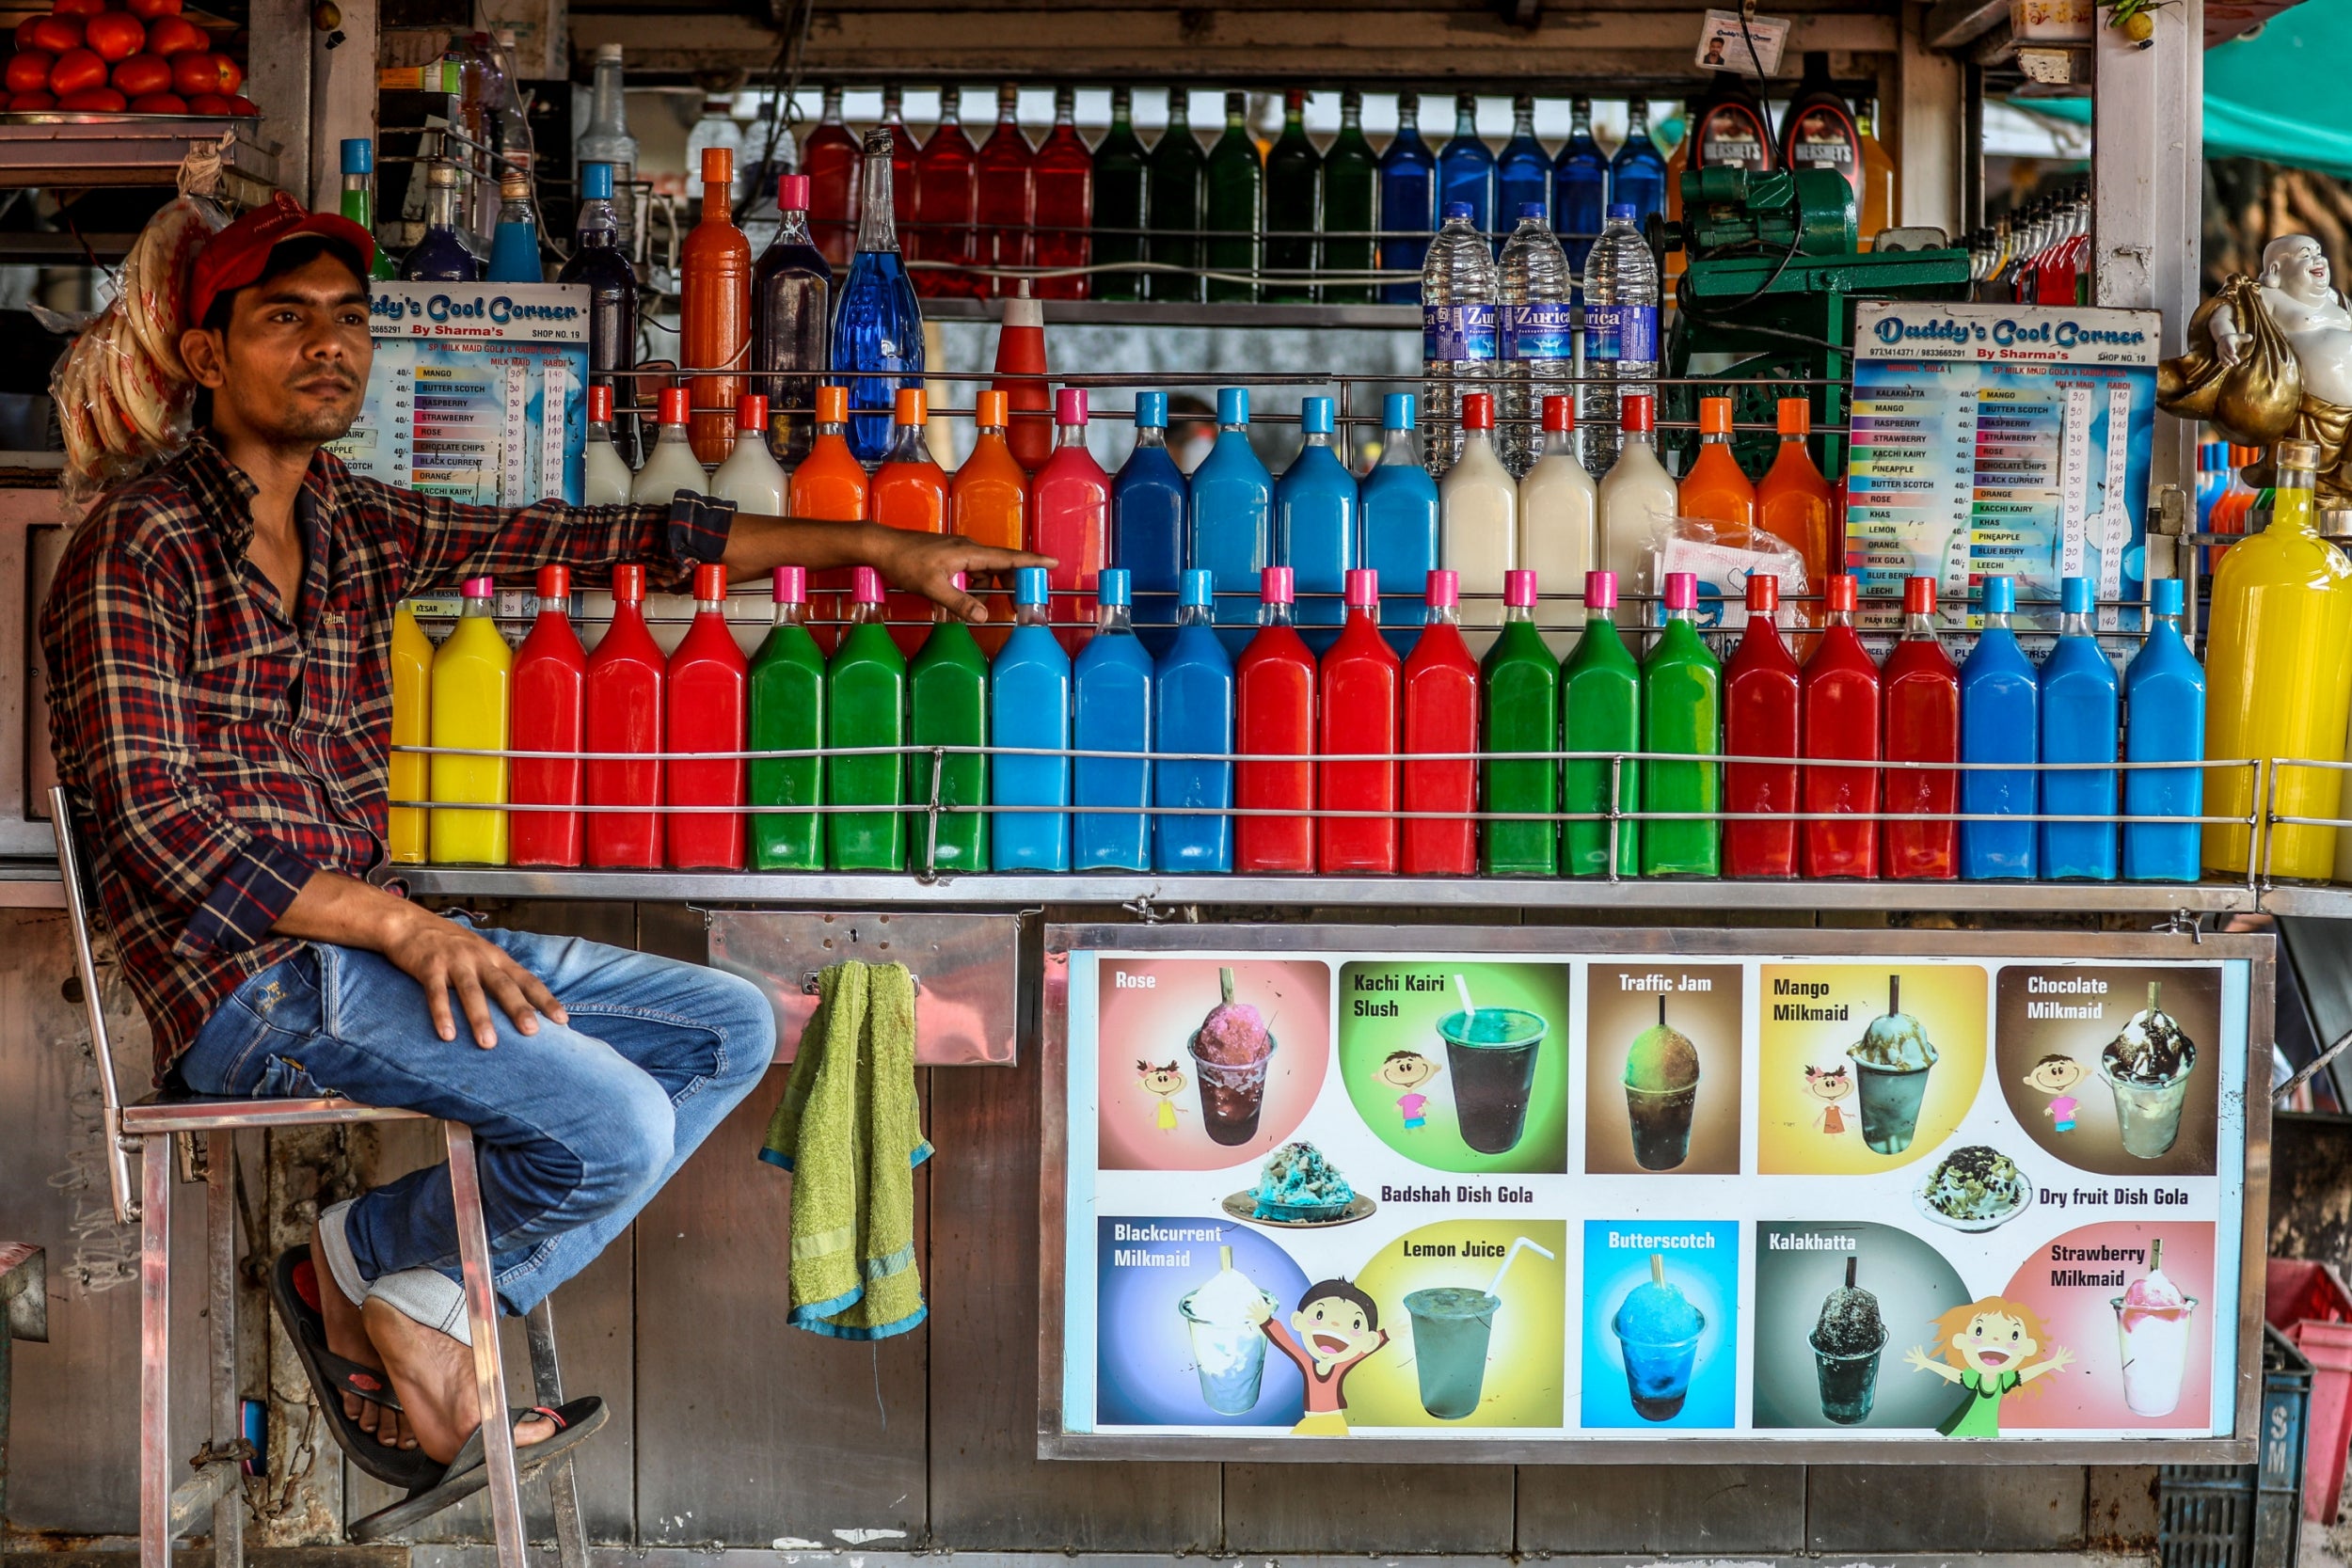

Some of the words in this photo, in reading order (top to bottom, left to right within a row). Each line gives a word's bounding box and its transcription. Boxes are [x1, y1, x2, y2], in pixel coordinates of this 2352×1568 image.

[427, 294, 484, 322] Cool
[489, 296, 578, 324] Corner
[1517, 307, 1570, 325] Zurica
[413, 325, 430, 336] By
[435, 325, 503, 337] Sharma's
[1874, 317, 1986, 344] Daddy's
[1993, 319, 2051, 346] Cool
[2055, 321, 2145, 347] Corner
[1977, 348, 1994, 359] By
[1999, 349, 2069, 360] Sharma's
[1115, 971, 1156, 989] Rose
[1354, 974, 1400, 991] Kachi
[1405, 974, 1445, 992] Kairi
[1619, 974, 1674, 991] Traffic
[1677, 975, 1712, 992] Jam
[2027, 976, 2107, 995] Chocolate
[1773, 979, 1830, 1001] Mango
[1354, 1000, 1399, 1018] Slush
[1773, 1004, 1849, 1022] Milkmaid
[2027, 1001, 2103, 1020] Milkmaid
[1381, 1185, 1453, 1203] Badshah
[1456, 1186, 1492, 1203] Dish
[1497, 1187, 1534, 1204] Gola
[2040, 1189, 2069, 1209] Dry
[2073, 1188, 2109, 1206] fruit
[2114, 1188, 2149, 1206] Dish
[2153, 1188, 2188, 1206] Gola
[1114, 1224, 1222, 1243] Blackcurrent
[1609, 1231, 1715, 1249] Butterscotch
[1769, 1233, 1857, 1251] Kalakhatta
[1114, 1249, 1191, 1268] Milkmaid
[1403, 1241, 1455, 1258] Lemon
[1461, 1241, 1506, 1258] Juice
[2052, 1244, 2145, 1265] Strawberry
[2052, 1269, 2125, 1288] Milkmaid
